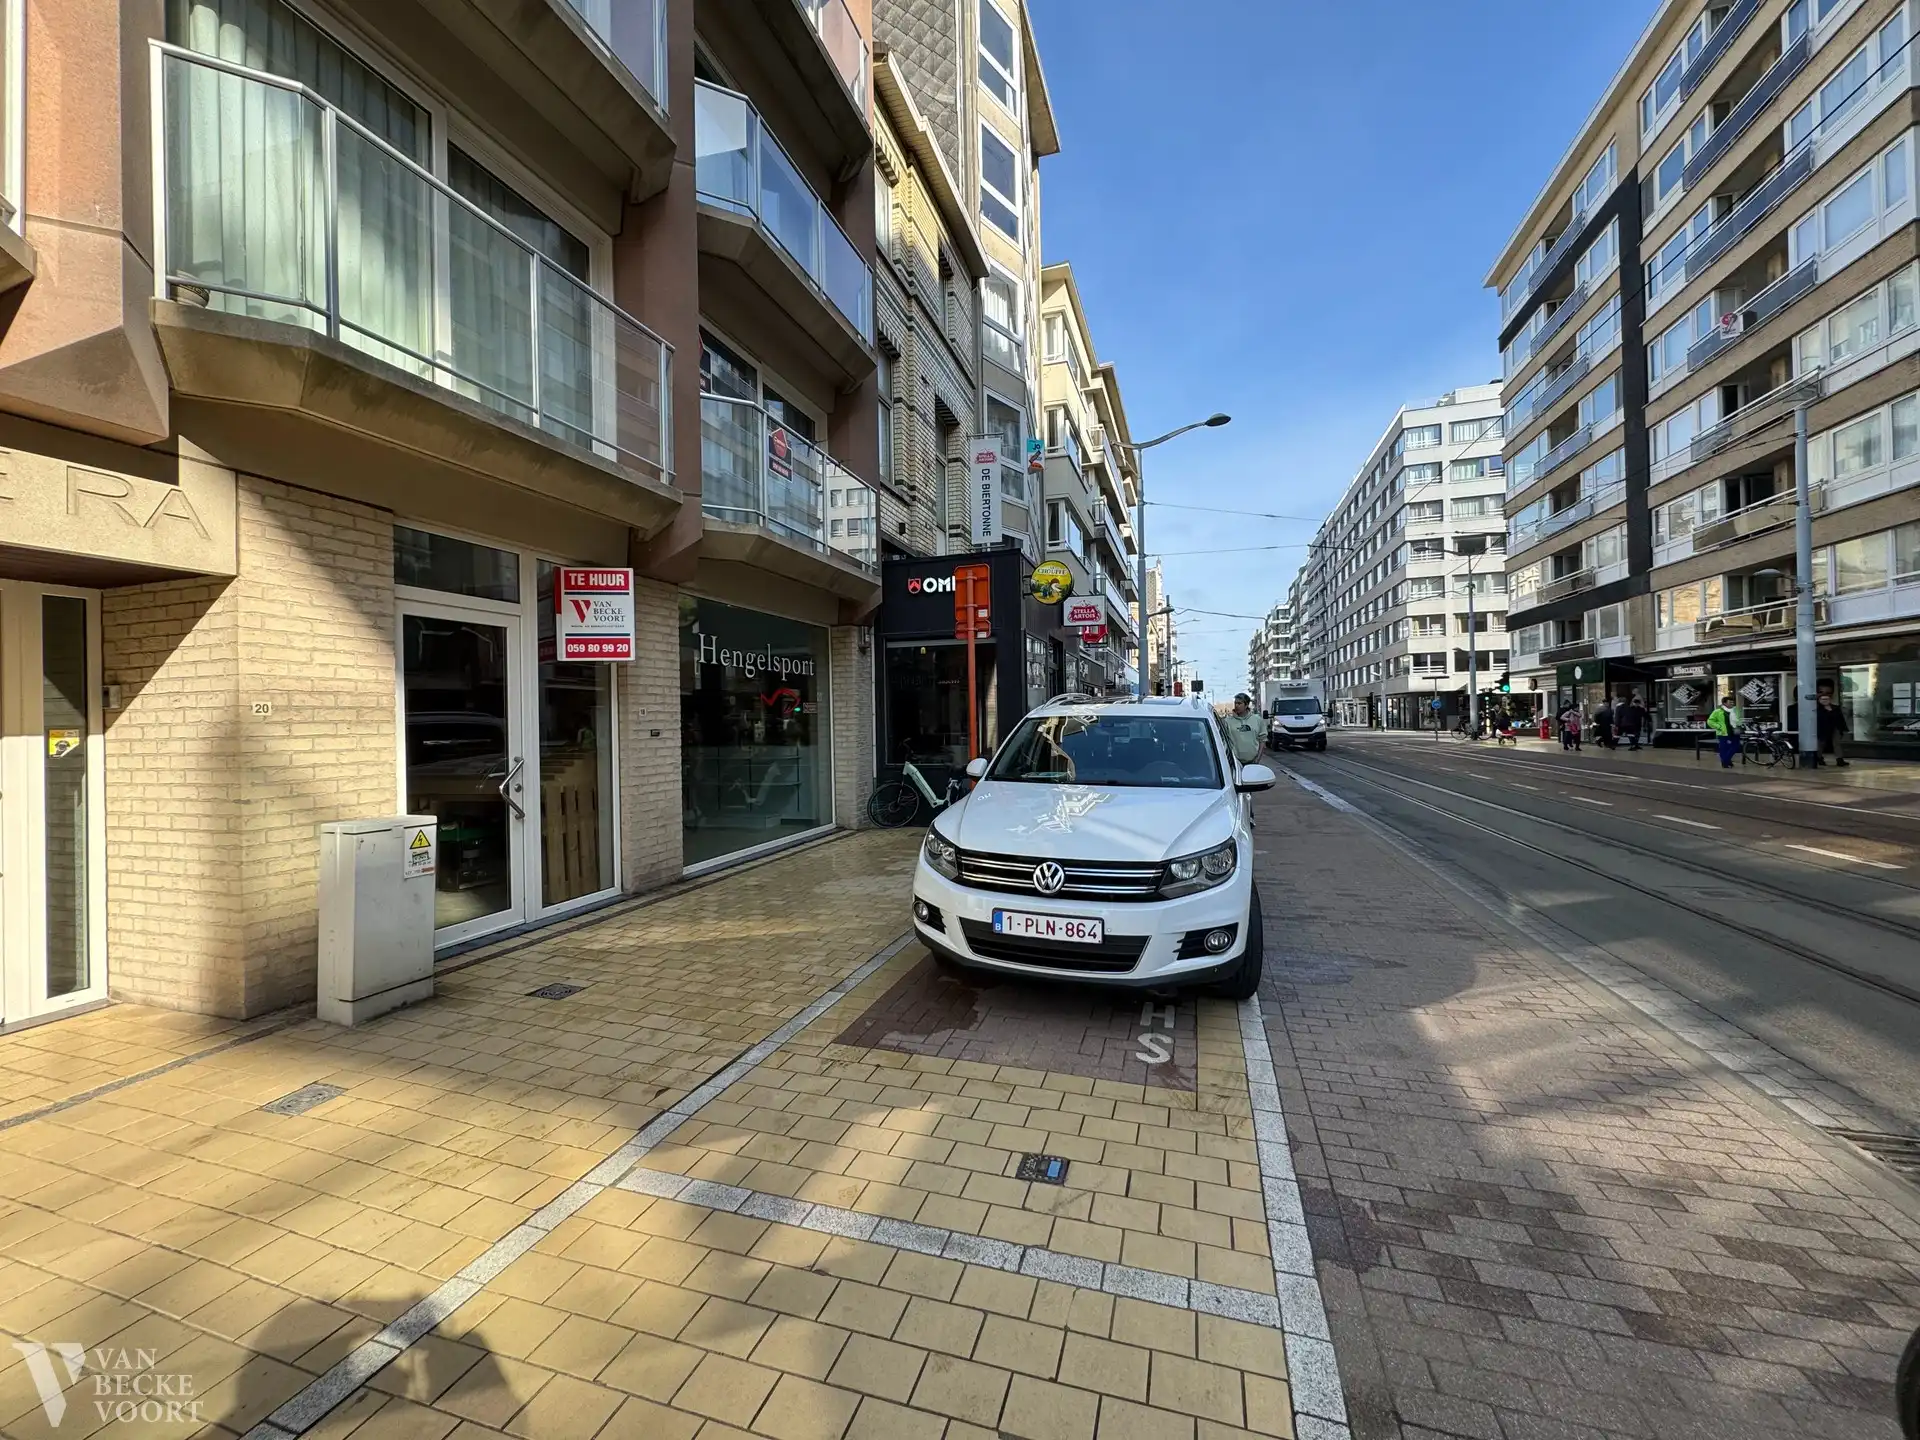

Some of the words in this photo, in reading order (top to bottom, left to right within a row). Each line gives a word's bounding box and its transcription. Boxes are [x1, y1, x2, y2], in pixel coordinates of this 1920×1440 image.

[981, 468, 991, 481] DE
[981, 484, 991, 537] BIERTONNE
[569, 573, 585, 586] TE
[589, 573, 625, 586] HUUR
[567, 644, 585, 653] 059
[587, 644, 600, 653] 80
[602, 644, 614, 653] 99
[616, 644, 629, 653] 20
[698, 633, 815, 681] Hengelsport
[255, 704, 269, 713] 20
[995, 923, 1002, 931] B
[1007, 916, 1097, 939] 1-PLN-864
